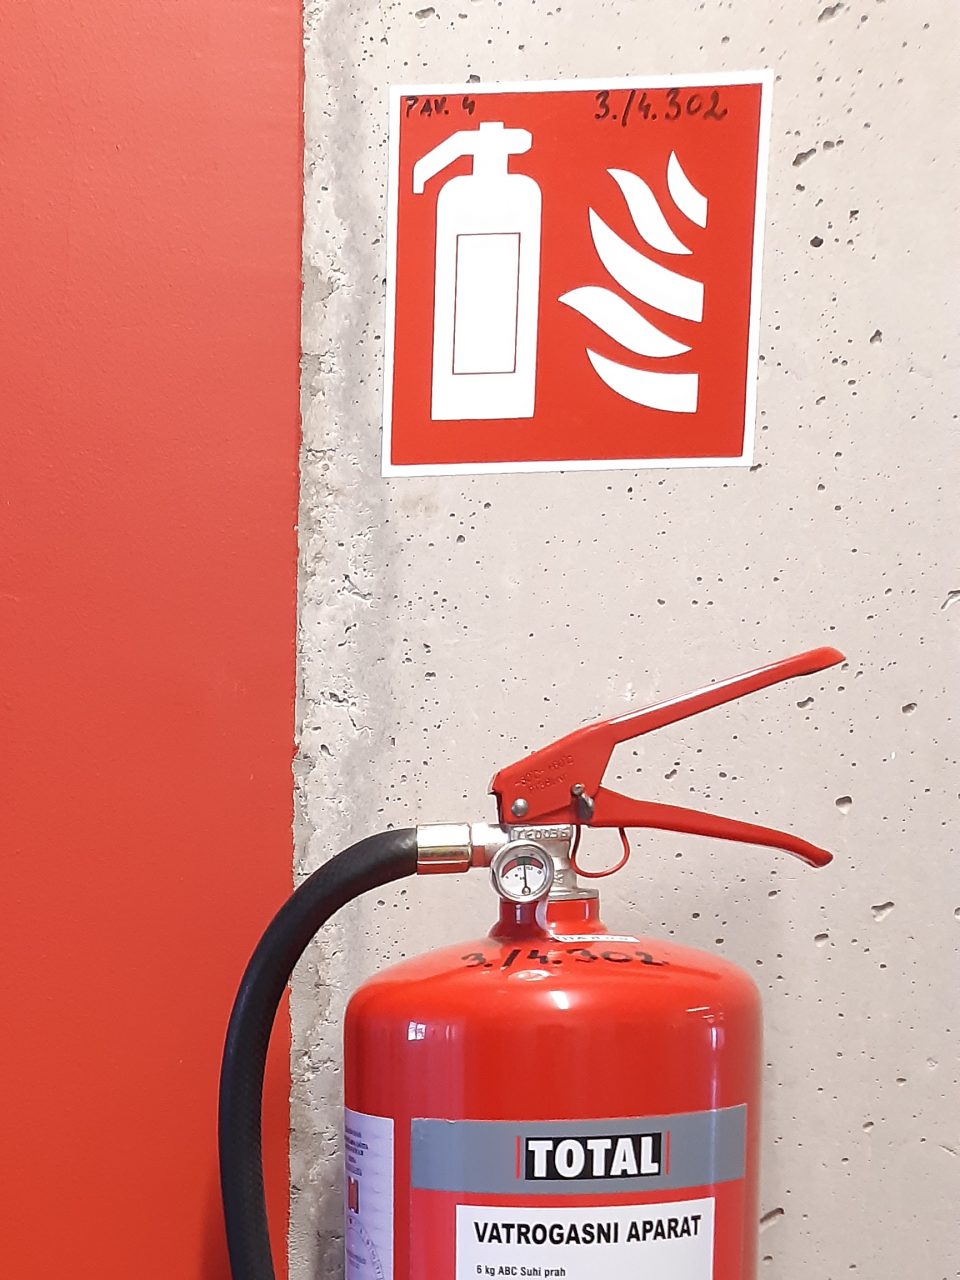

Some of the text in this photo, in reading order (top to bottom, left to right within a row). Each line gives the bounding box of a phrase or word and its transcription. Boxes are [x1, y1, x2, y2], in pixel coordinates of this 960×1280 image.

[528, 1136, 660, 1178] TOTAL
[474, 1215, 701, 1245] VATROGASNI APARAT
[476, 1265, 566, 1279] 6 kg ABC Suhi prah
